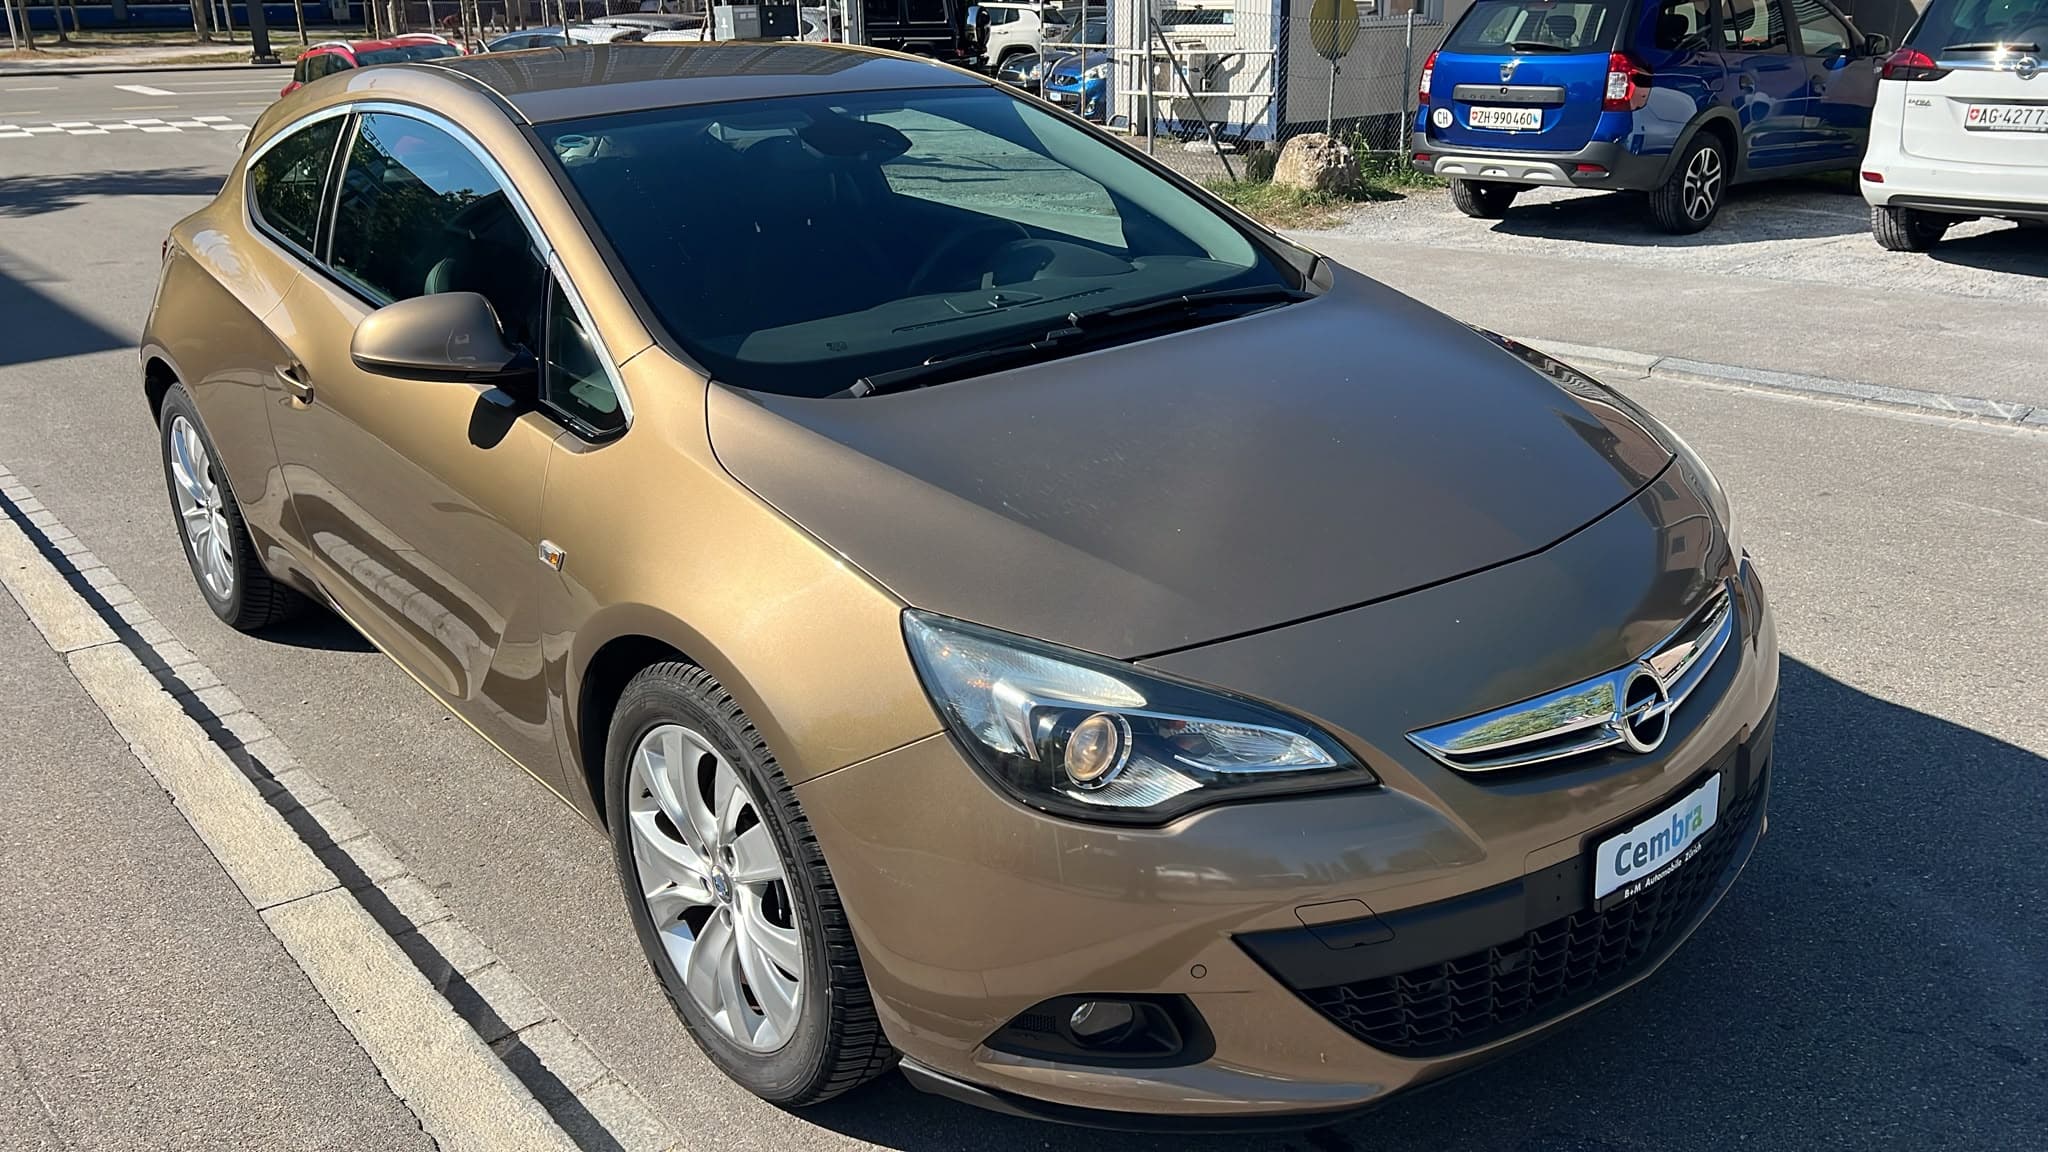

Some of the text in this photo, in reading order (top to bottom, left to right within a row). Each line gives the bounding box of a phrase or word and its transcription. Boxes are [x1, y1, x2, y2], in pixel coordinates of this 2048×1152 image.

[1437, 111, 1449, 125] CH
[1614, 804, 1703, 876] Cembra
[1645, 859, 1682, 888] Automobile
